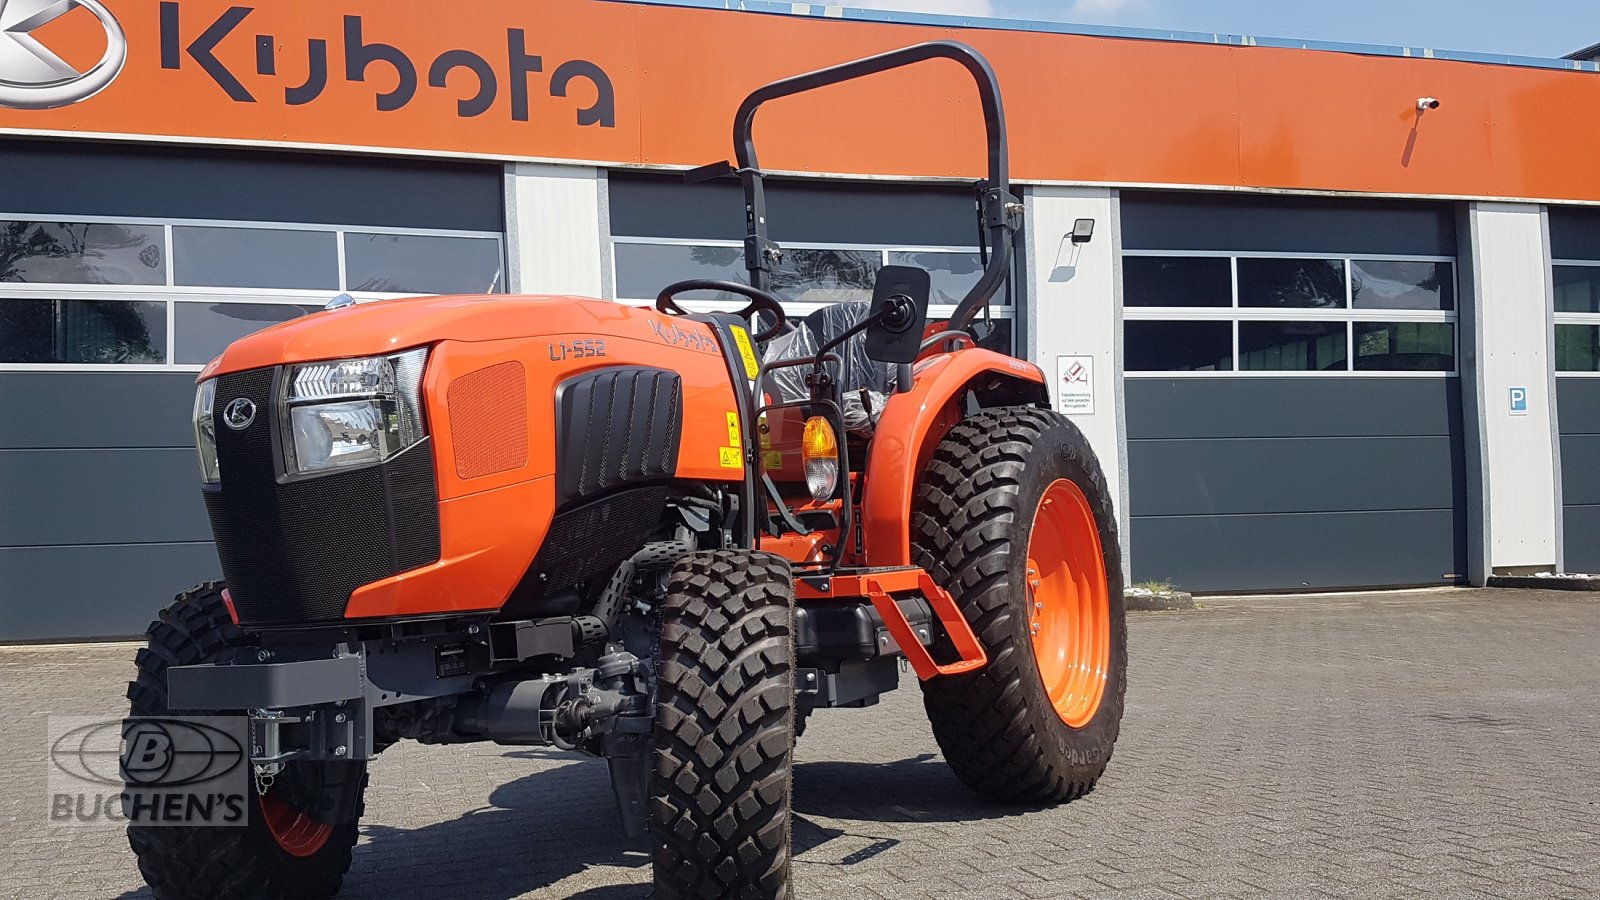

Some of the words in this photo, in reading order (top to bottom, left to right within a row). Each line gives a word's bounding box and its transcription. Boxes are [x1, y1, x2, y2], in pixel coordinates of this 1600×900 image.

[160, 1, 615, 128] Kubota
[647, 319, 718, 353] Kubota
[549, 339, 606, 362] L1-552
[1511, 389, 1524, 408] P
